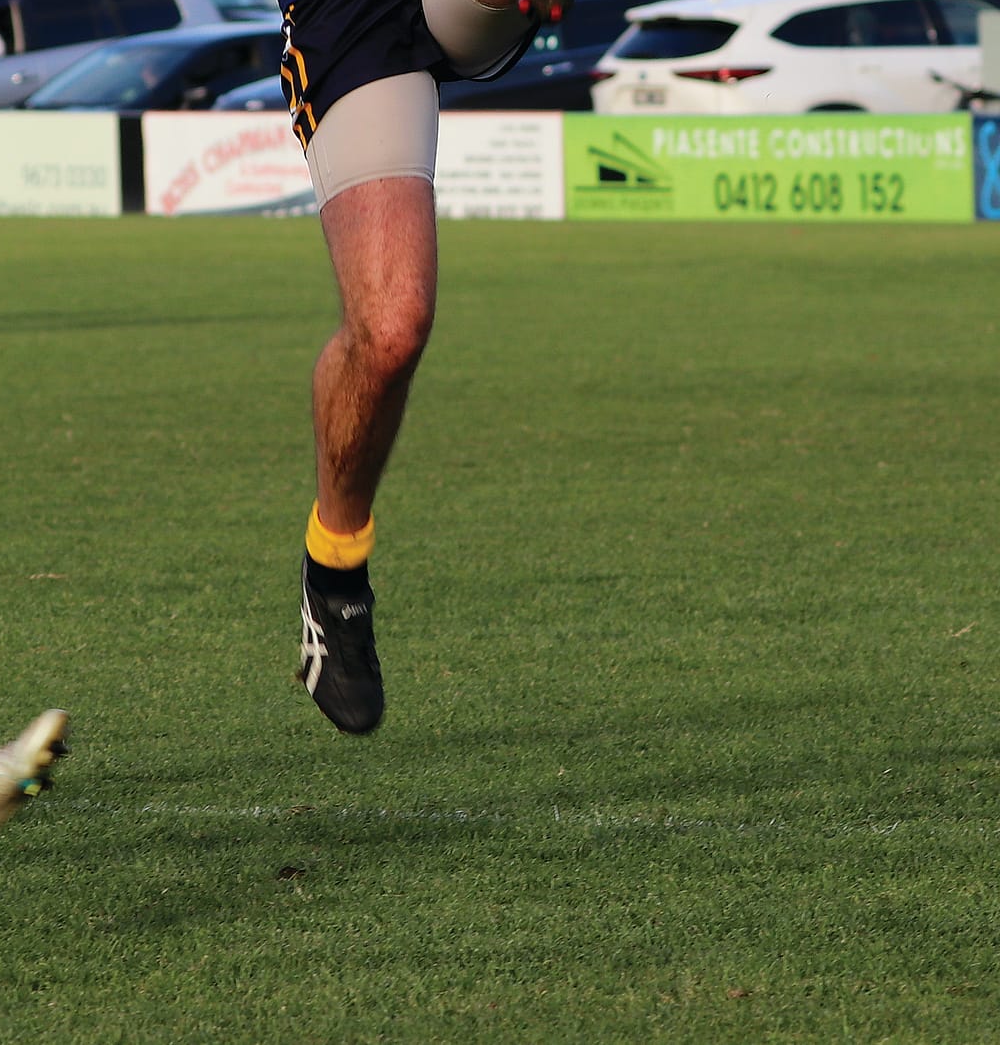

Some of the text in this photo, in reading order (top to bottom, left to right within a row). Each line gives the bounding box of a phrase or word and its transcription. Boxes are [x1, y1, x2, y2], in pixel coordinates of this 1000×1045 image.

[652, 127, 967, 161] PIASENTE CONSTRUCTIONS
[714, 172, 780, 213] 0412
[789, 172, 844, 213] 608
[857, 172, 905, 213] 152
